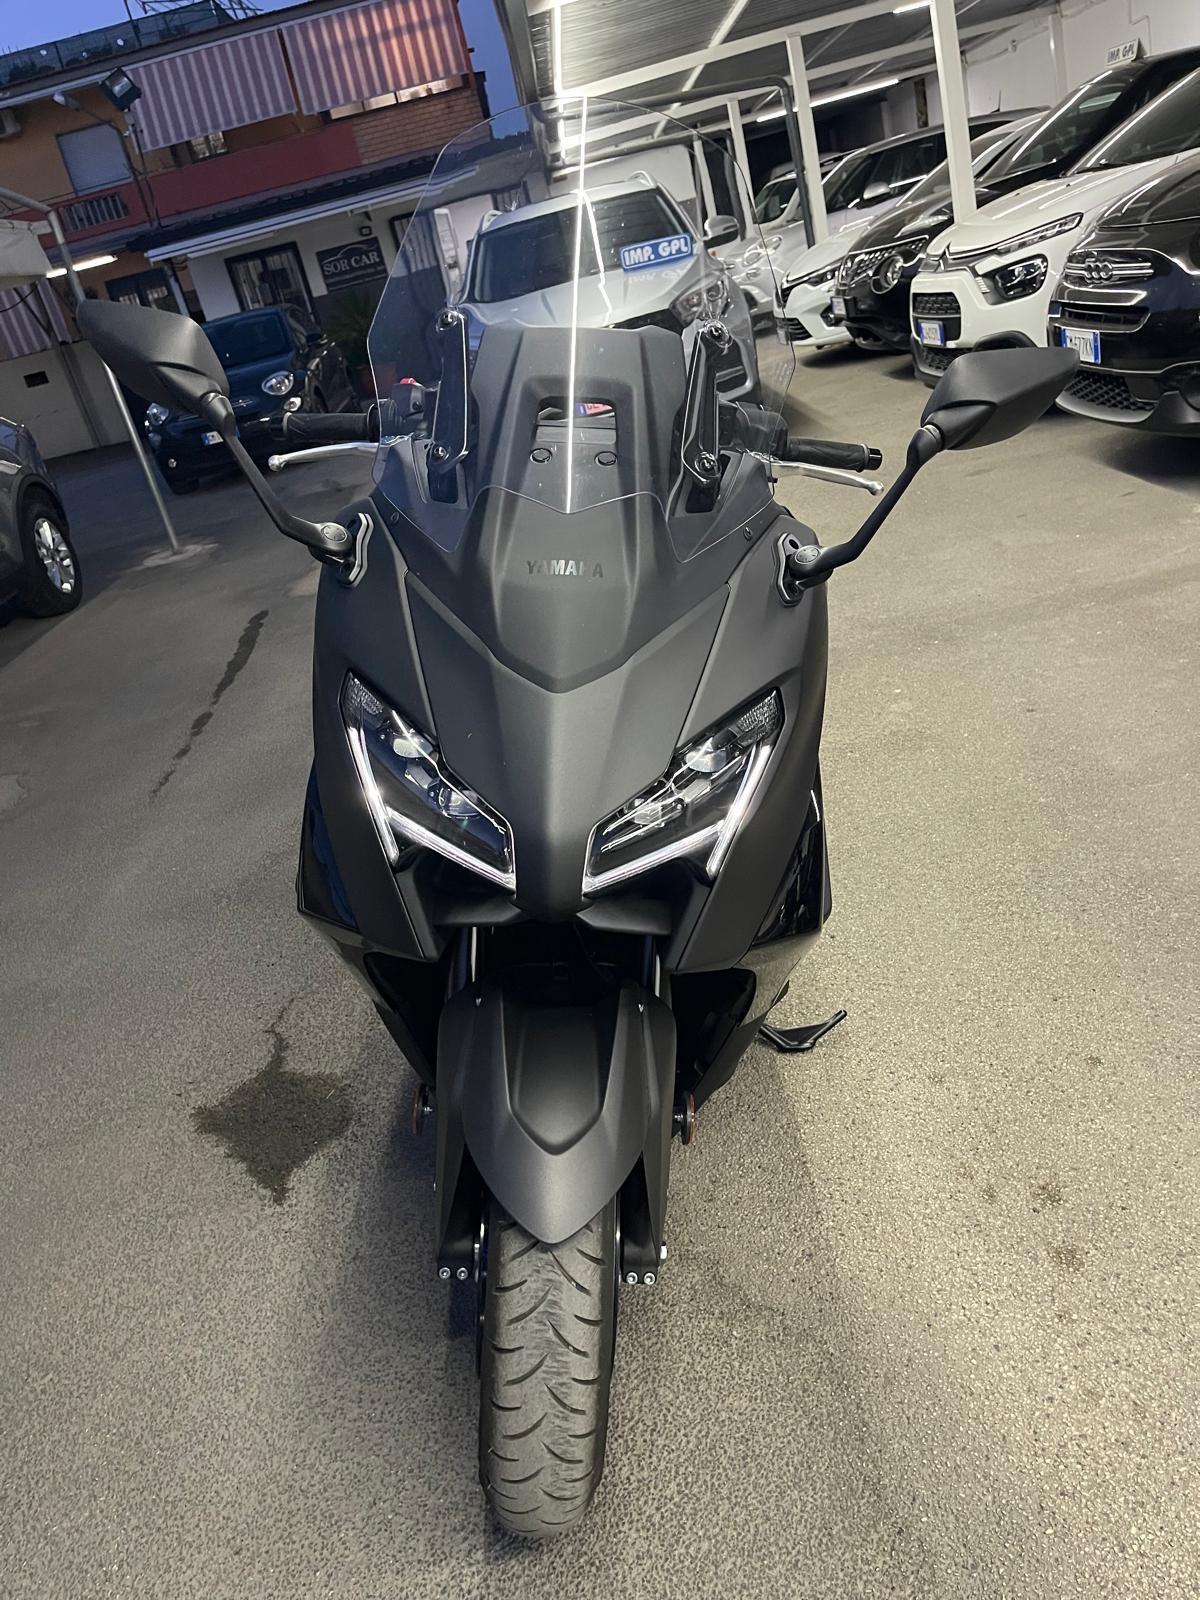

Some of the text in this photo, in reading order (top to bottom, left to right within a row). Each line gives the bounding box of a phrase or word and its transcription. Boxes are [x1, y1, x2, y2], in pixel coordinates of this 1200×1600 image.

[323, 251, 380, 275] SOR CAR
[624, 238, 688, 265] IMP. GPL
[526, 559, 604, 578] YAMAHA
